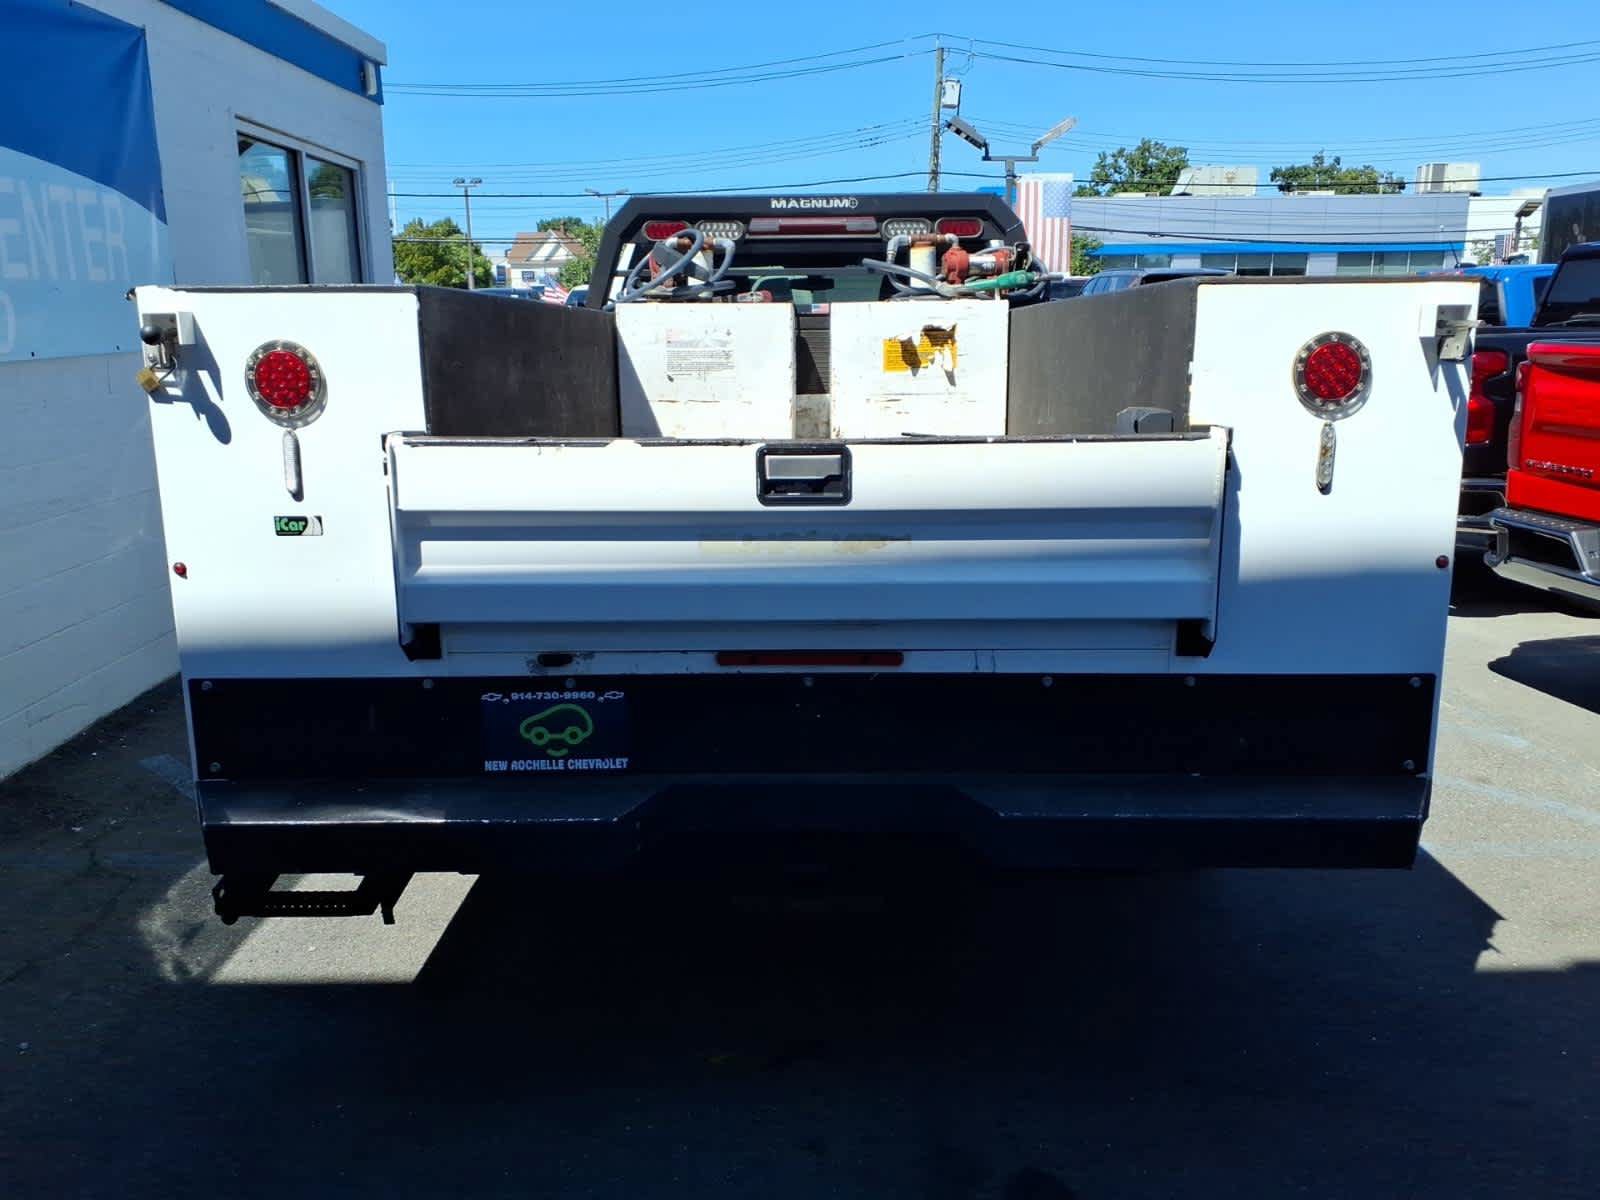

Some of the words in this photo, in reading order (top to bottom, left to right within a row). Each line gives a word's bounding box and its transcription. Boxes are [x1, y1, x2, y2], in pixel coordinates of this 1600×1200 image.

[770, 198, 849, 209] MAGNUM
[484, 760, 508, 772] NEW
[511, 759, 565, 771] ROCHELLE
[567, 758, 629, 770] CHEVROLET
